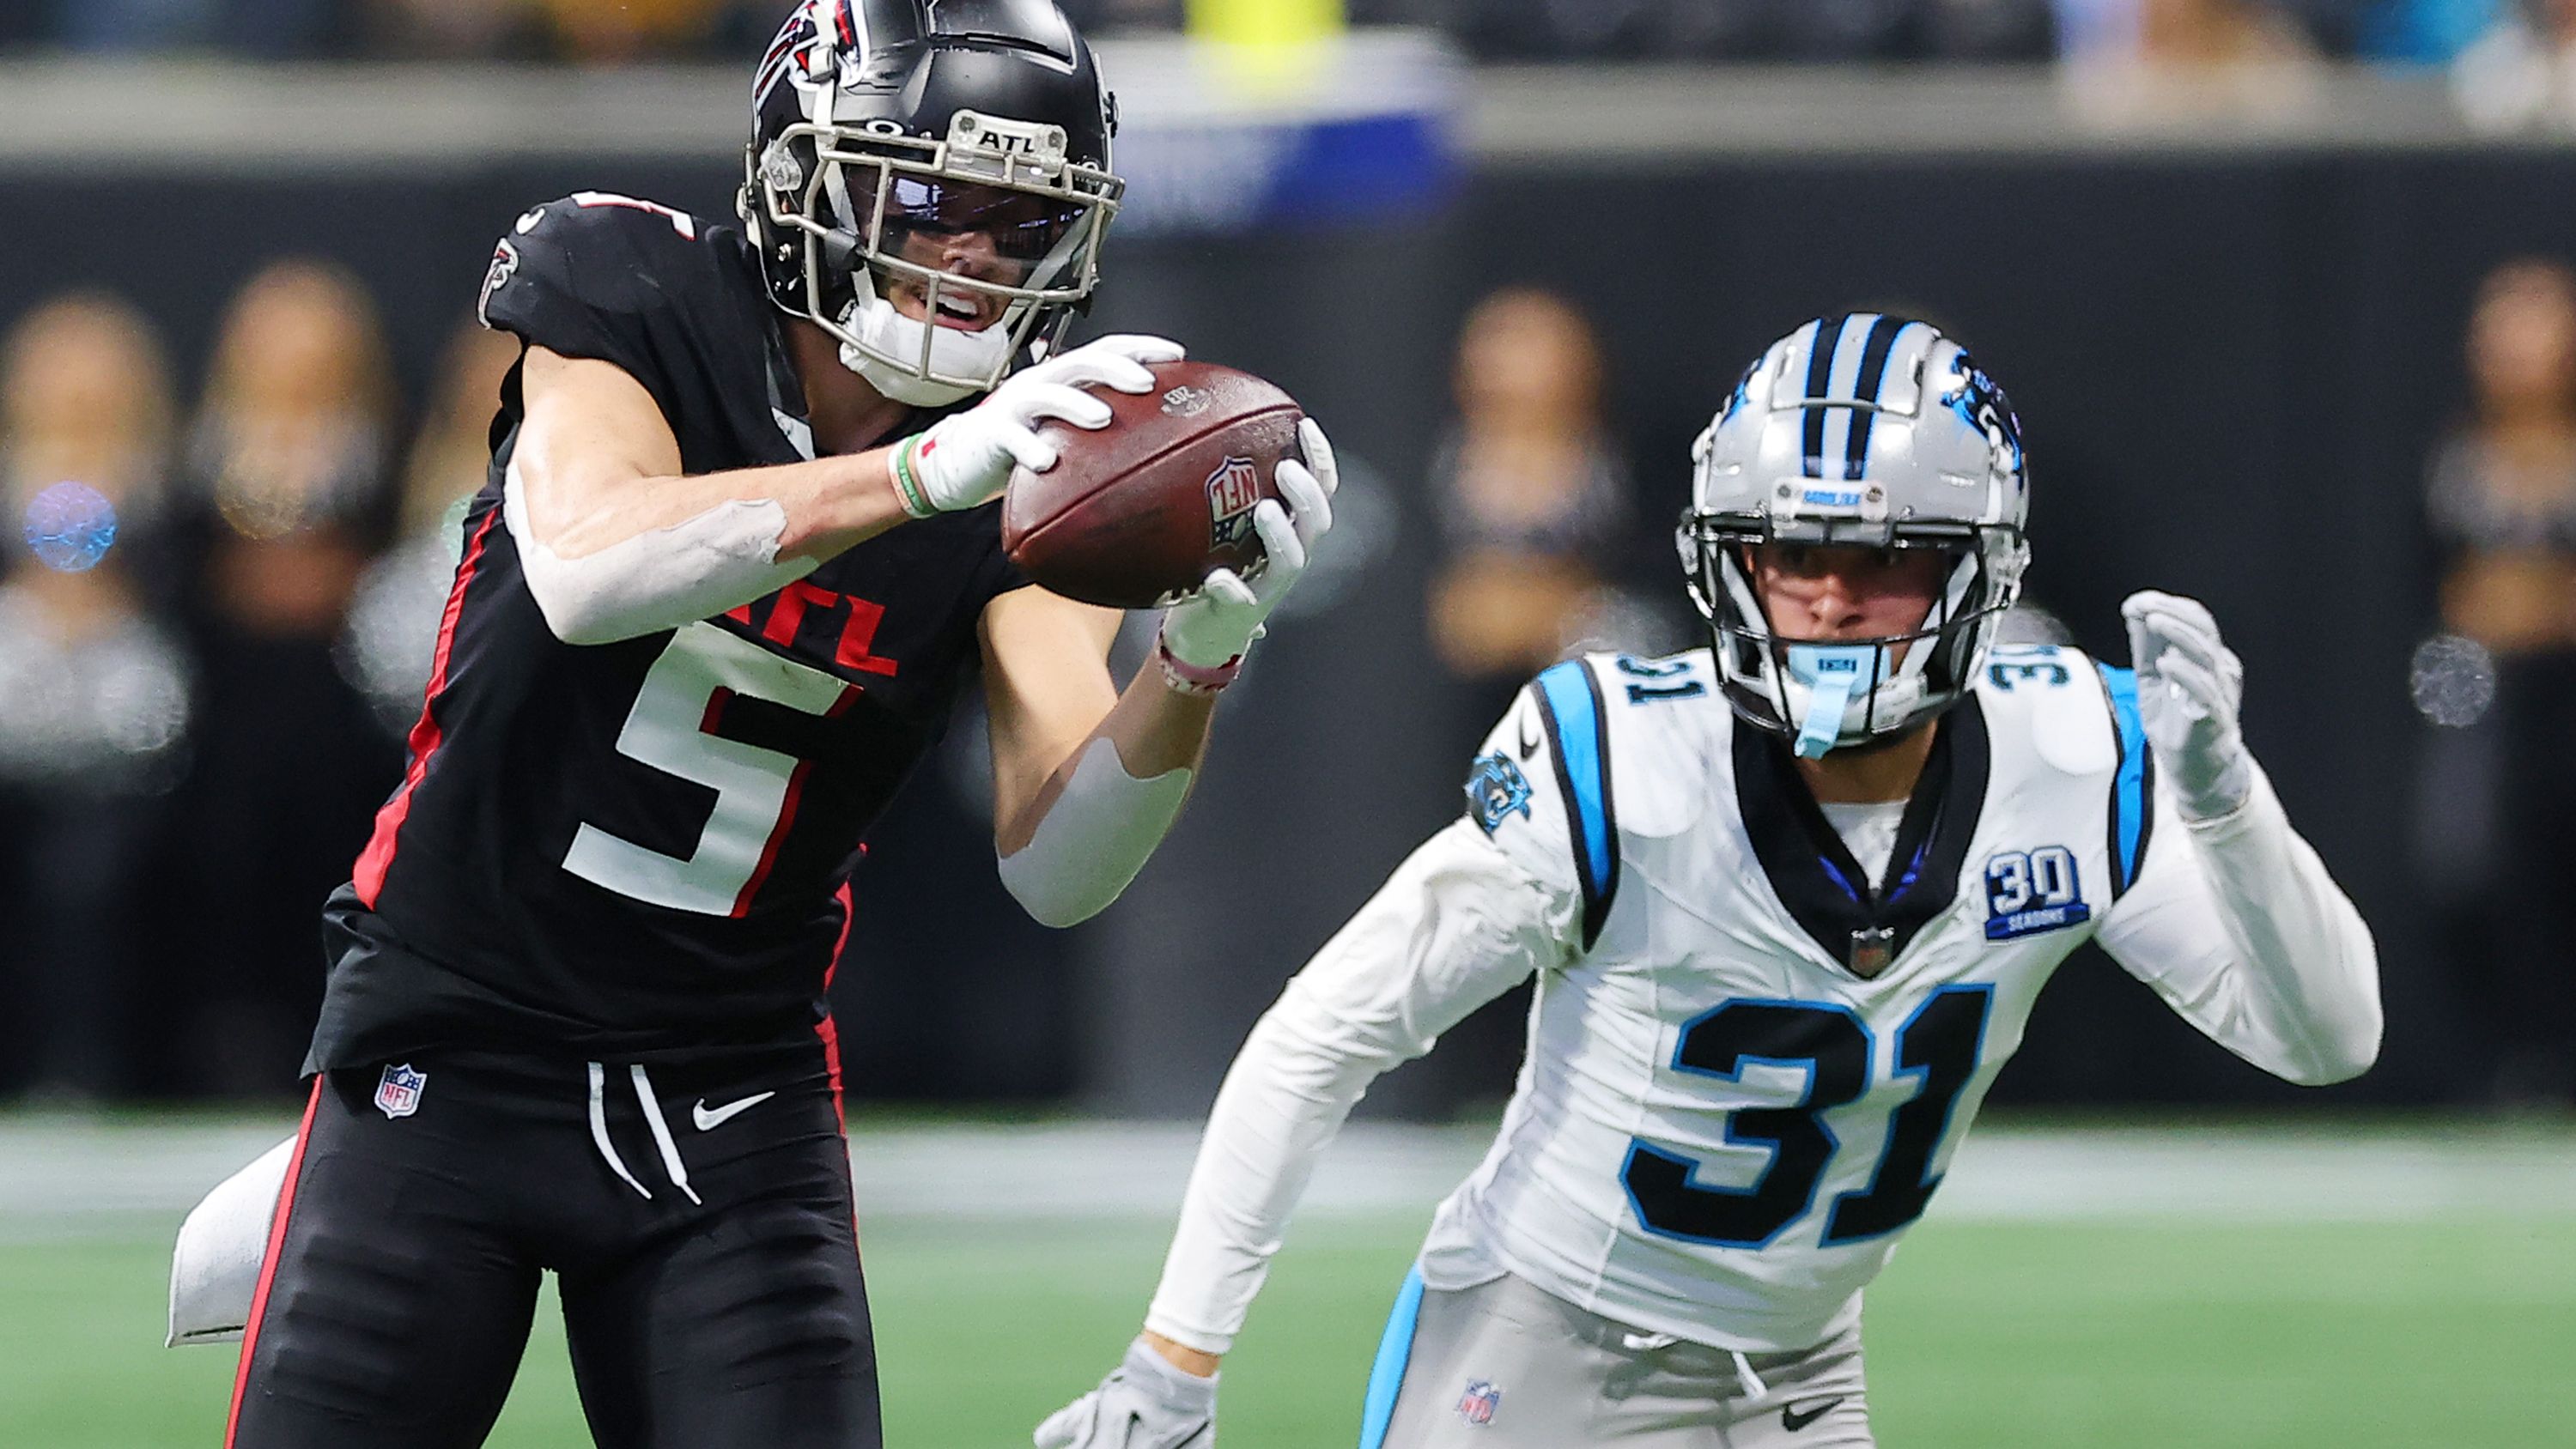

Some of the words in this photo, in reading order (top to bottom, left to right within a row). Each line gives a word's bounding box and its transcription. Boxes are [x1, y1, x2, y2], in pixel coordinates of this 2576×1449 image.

[979, 130, 1035, 153] ATL
[1212, 468, 1258, 516] NFL
[724, 579, 898, 677] TL
[561, 621, 863, 918] 5
[1988, 846, 2078, 916] 30
[383, 1083, 410, 1108] NFL
[1619, 981, 1996, 1252] 31
